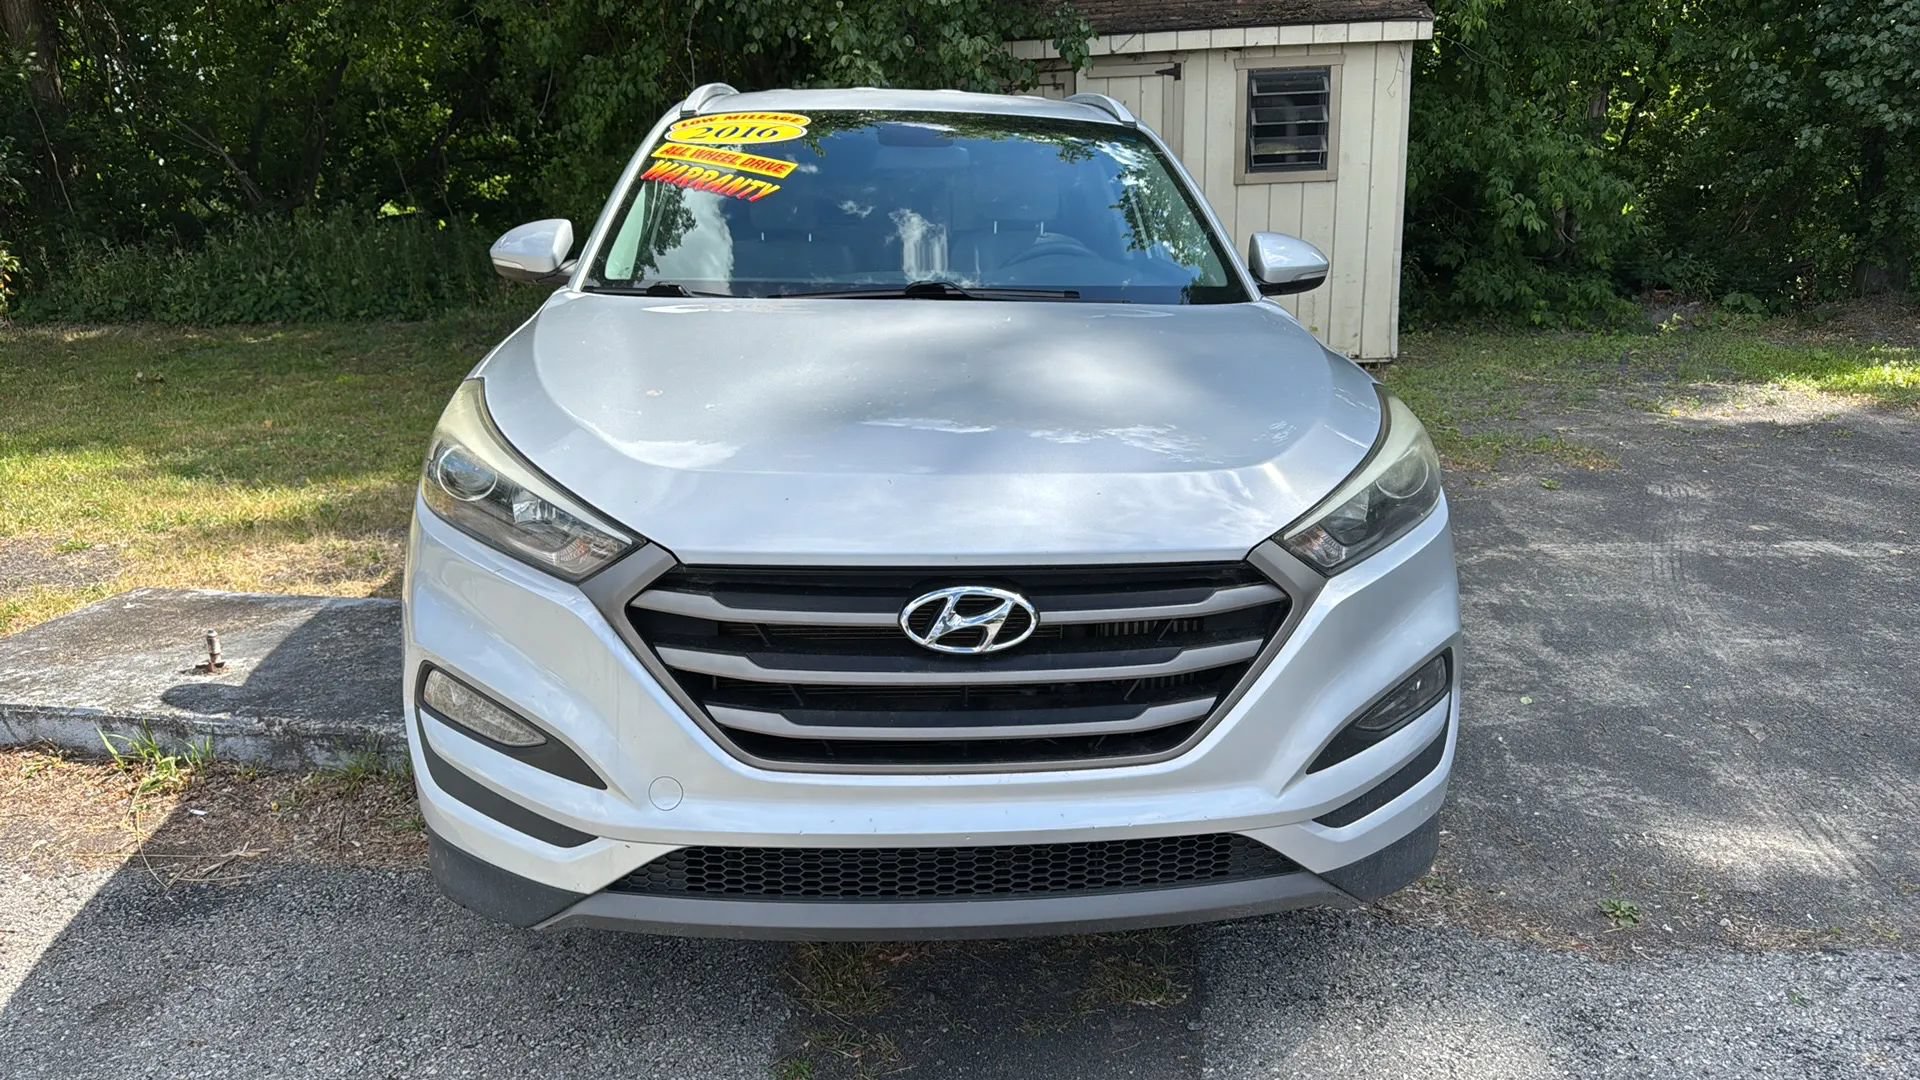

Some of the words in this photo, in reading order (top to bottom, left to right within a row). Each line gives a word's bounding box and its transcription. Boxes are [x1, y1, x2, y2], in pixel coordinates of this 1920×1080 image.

[682, 116, 718, 127] LOW
[724, 114, 803, 123] MILEAGE
[689, 125, 779, 139] 2016
[661, 145, 690, 156] ALL
[691, 148, 741, 165] WHEEL
[740, 157, 788, 173] DRIVE
[640, 159, 782, 202] WARRANTY
